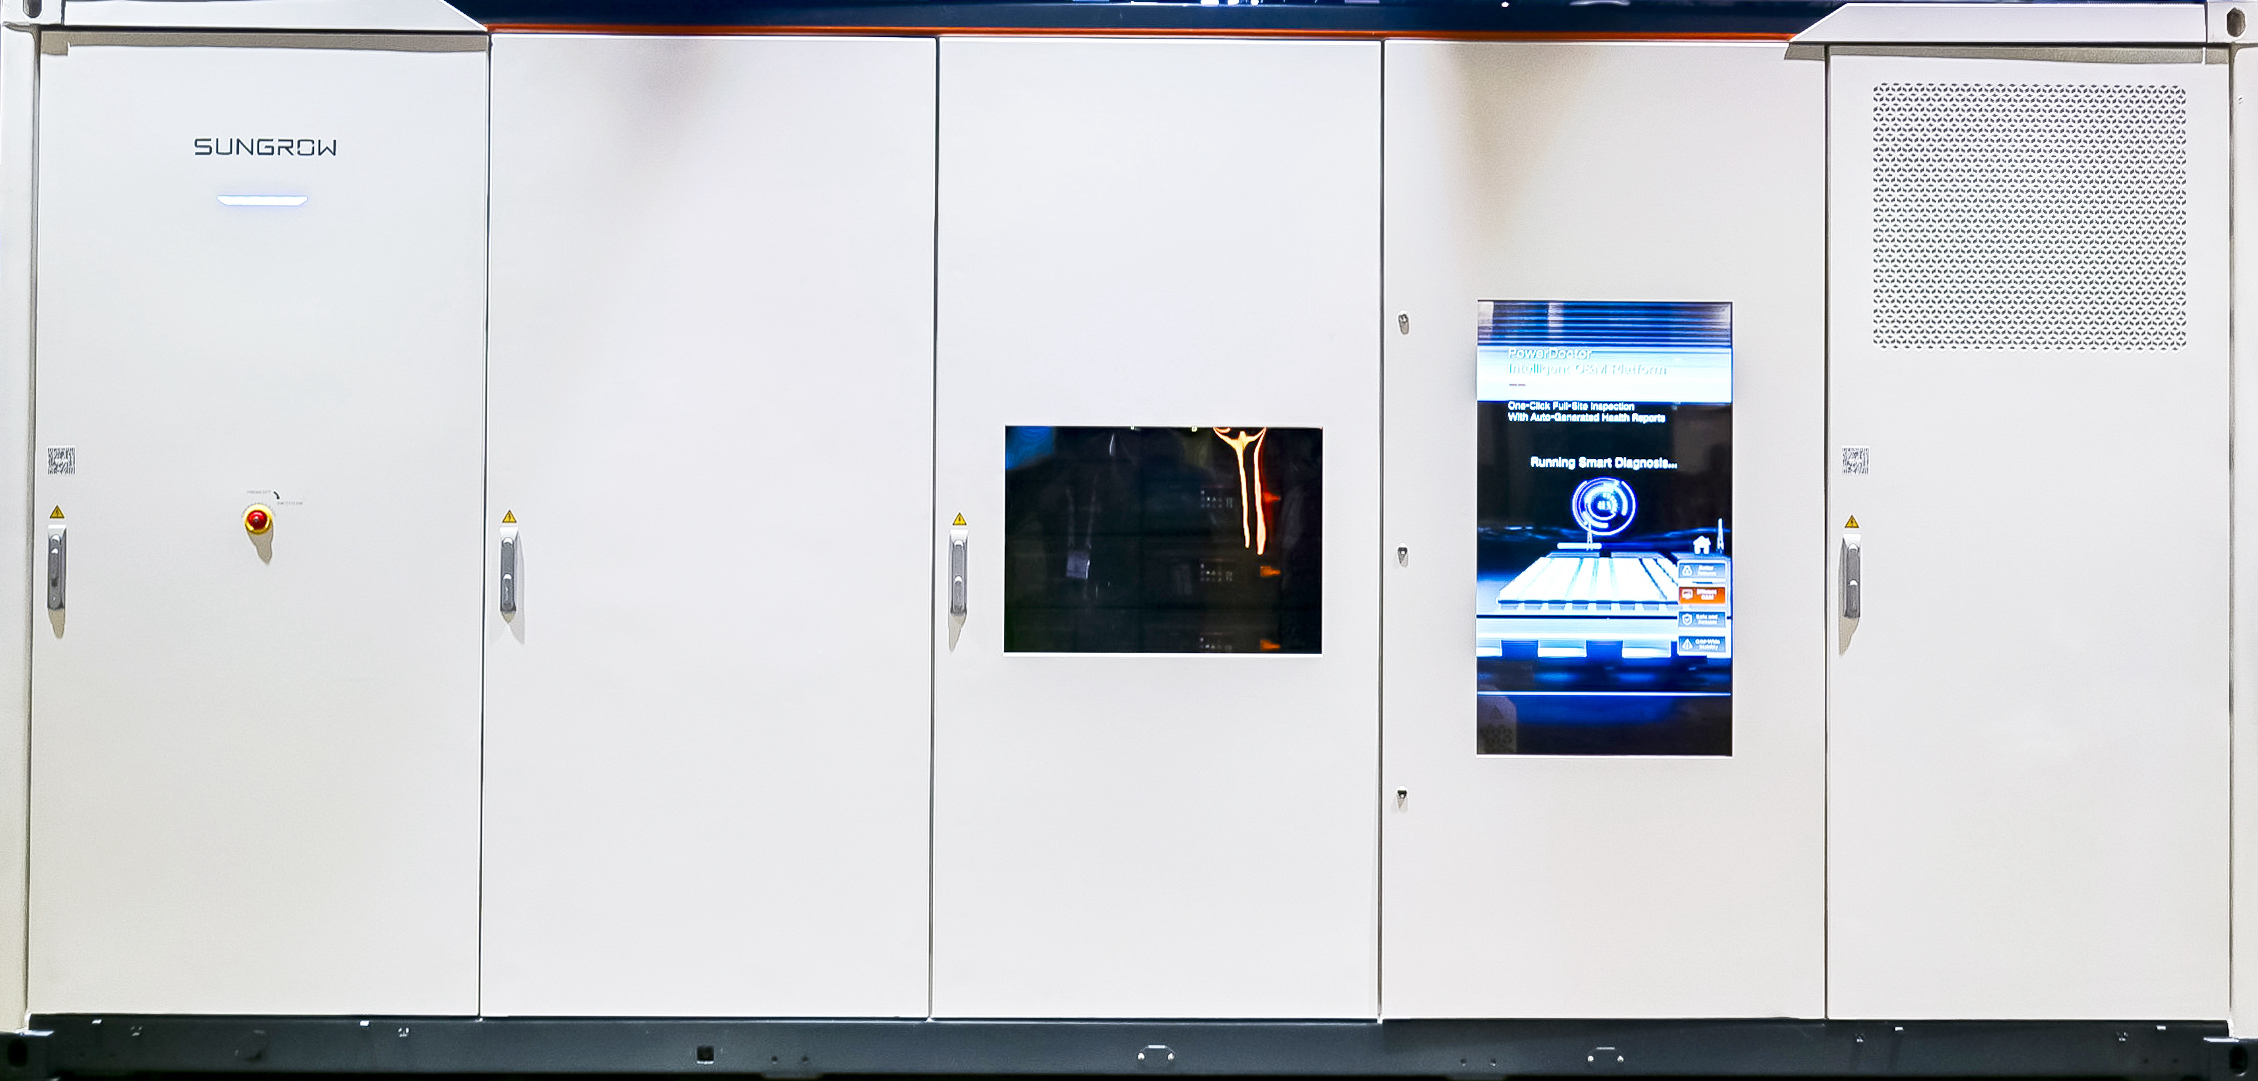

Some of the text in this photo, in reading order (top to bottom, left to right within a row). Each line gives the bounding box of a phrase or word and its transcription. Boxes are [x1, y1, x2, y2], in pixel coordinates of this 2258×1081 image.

[194, 138, 337, 156] SUNGROW
[1508, 347, 1592, 360] PowerDoctor
[1612, 363, 1667, 375] Platform
[1508, 401, 1635, 412] One-Click Full-Site Inspection
[1508, 412, 1666, 424] With Auto-Generated Health Reports
[1530, 456, 1678, 471] Running Smart Diagnosis...
